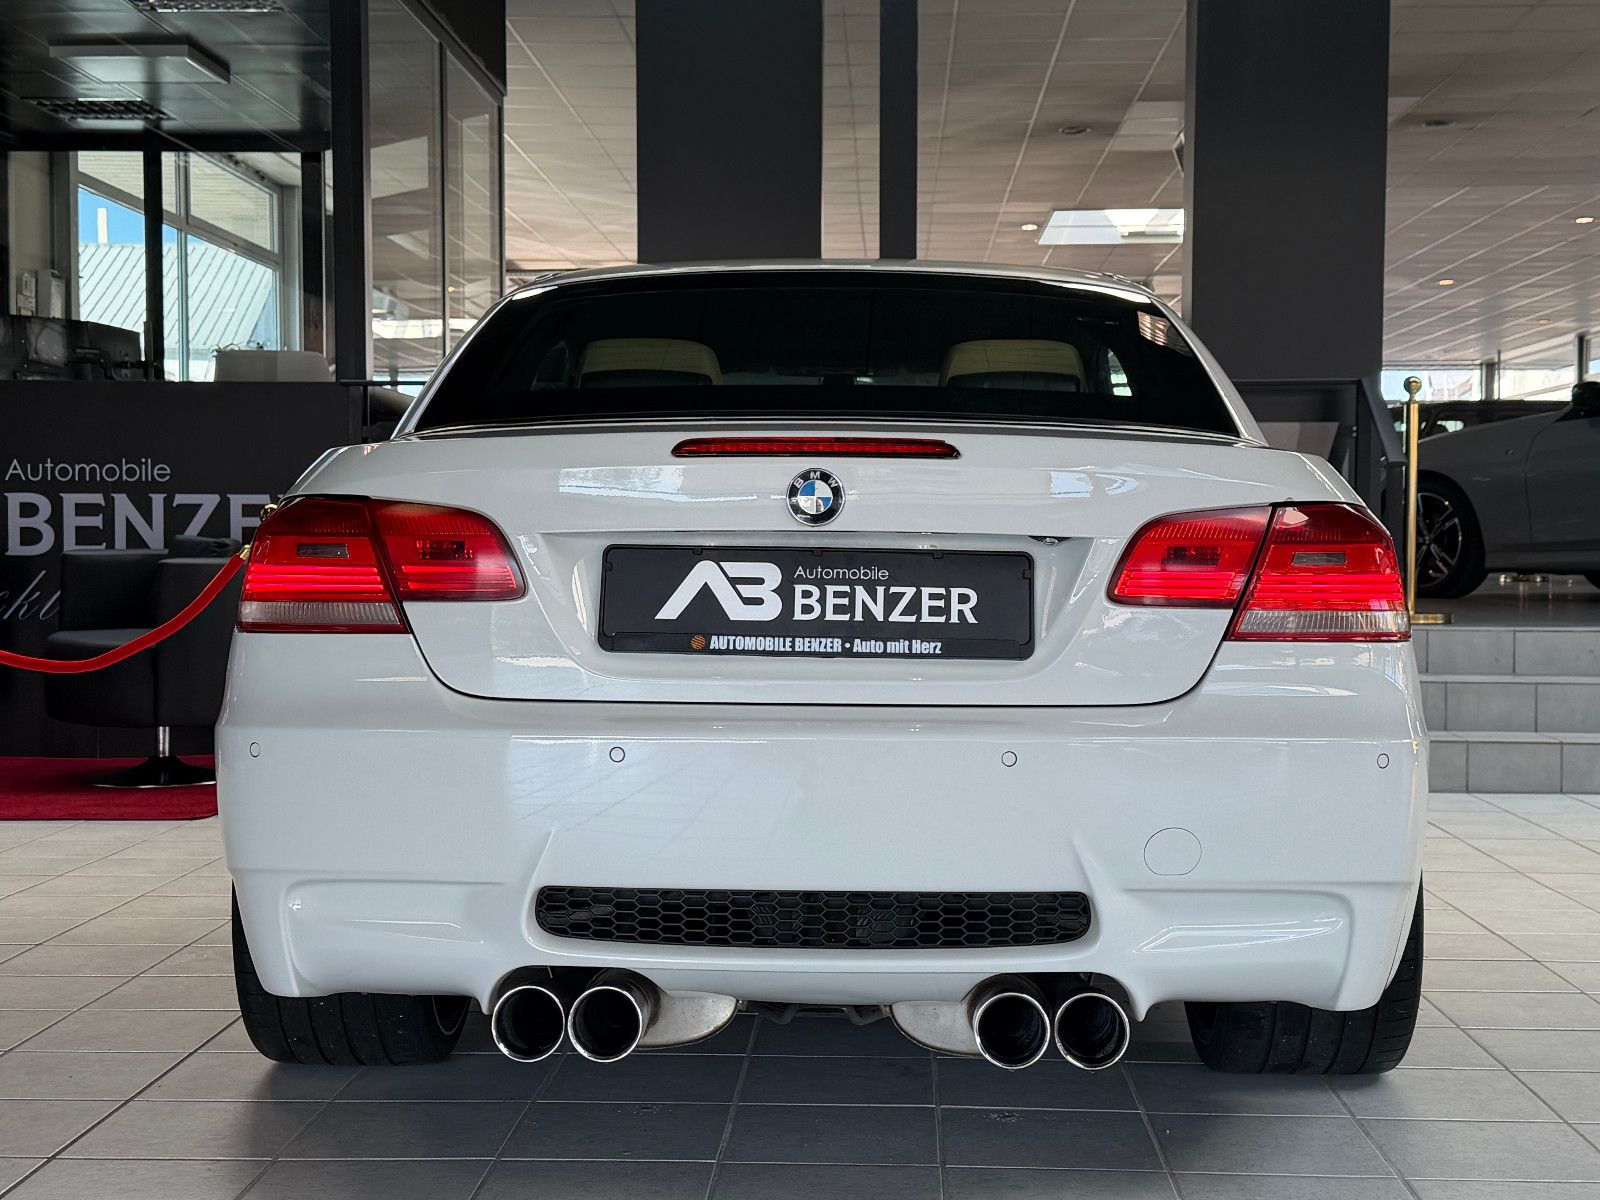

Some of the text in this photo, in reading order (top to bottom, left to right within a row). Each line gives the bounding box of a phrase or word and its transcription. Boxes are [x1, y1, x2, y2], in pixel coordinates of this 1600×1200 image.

[5, 458, 172, 482] Automobile
[792, 471, 839, 489] BMW
[4, 492, 285, 556] BENZE
[793, 565, 889, 580] Automobile
[792, 584, 978, 624] BENZER
[709, 635, 942, 654] AUTOMOBILE BENZER Auto mit Herz
